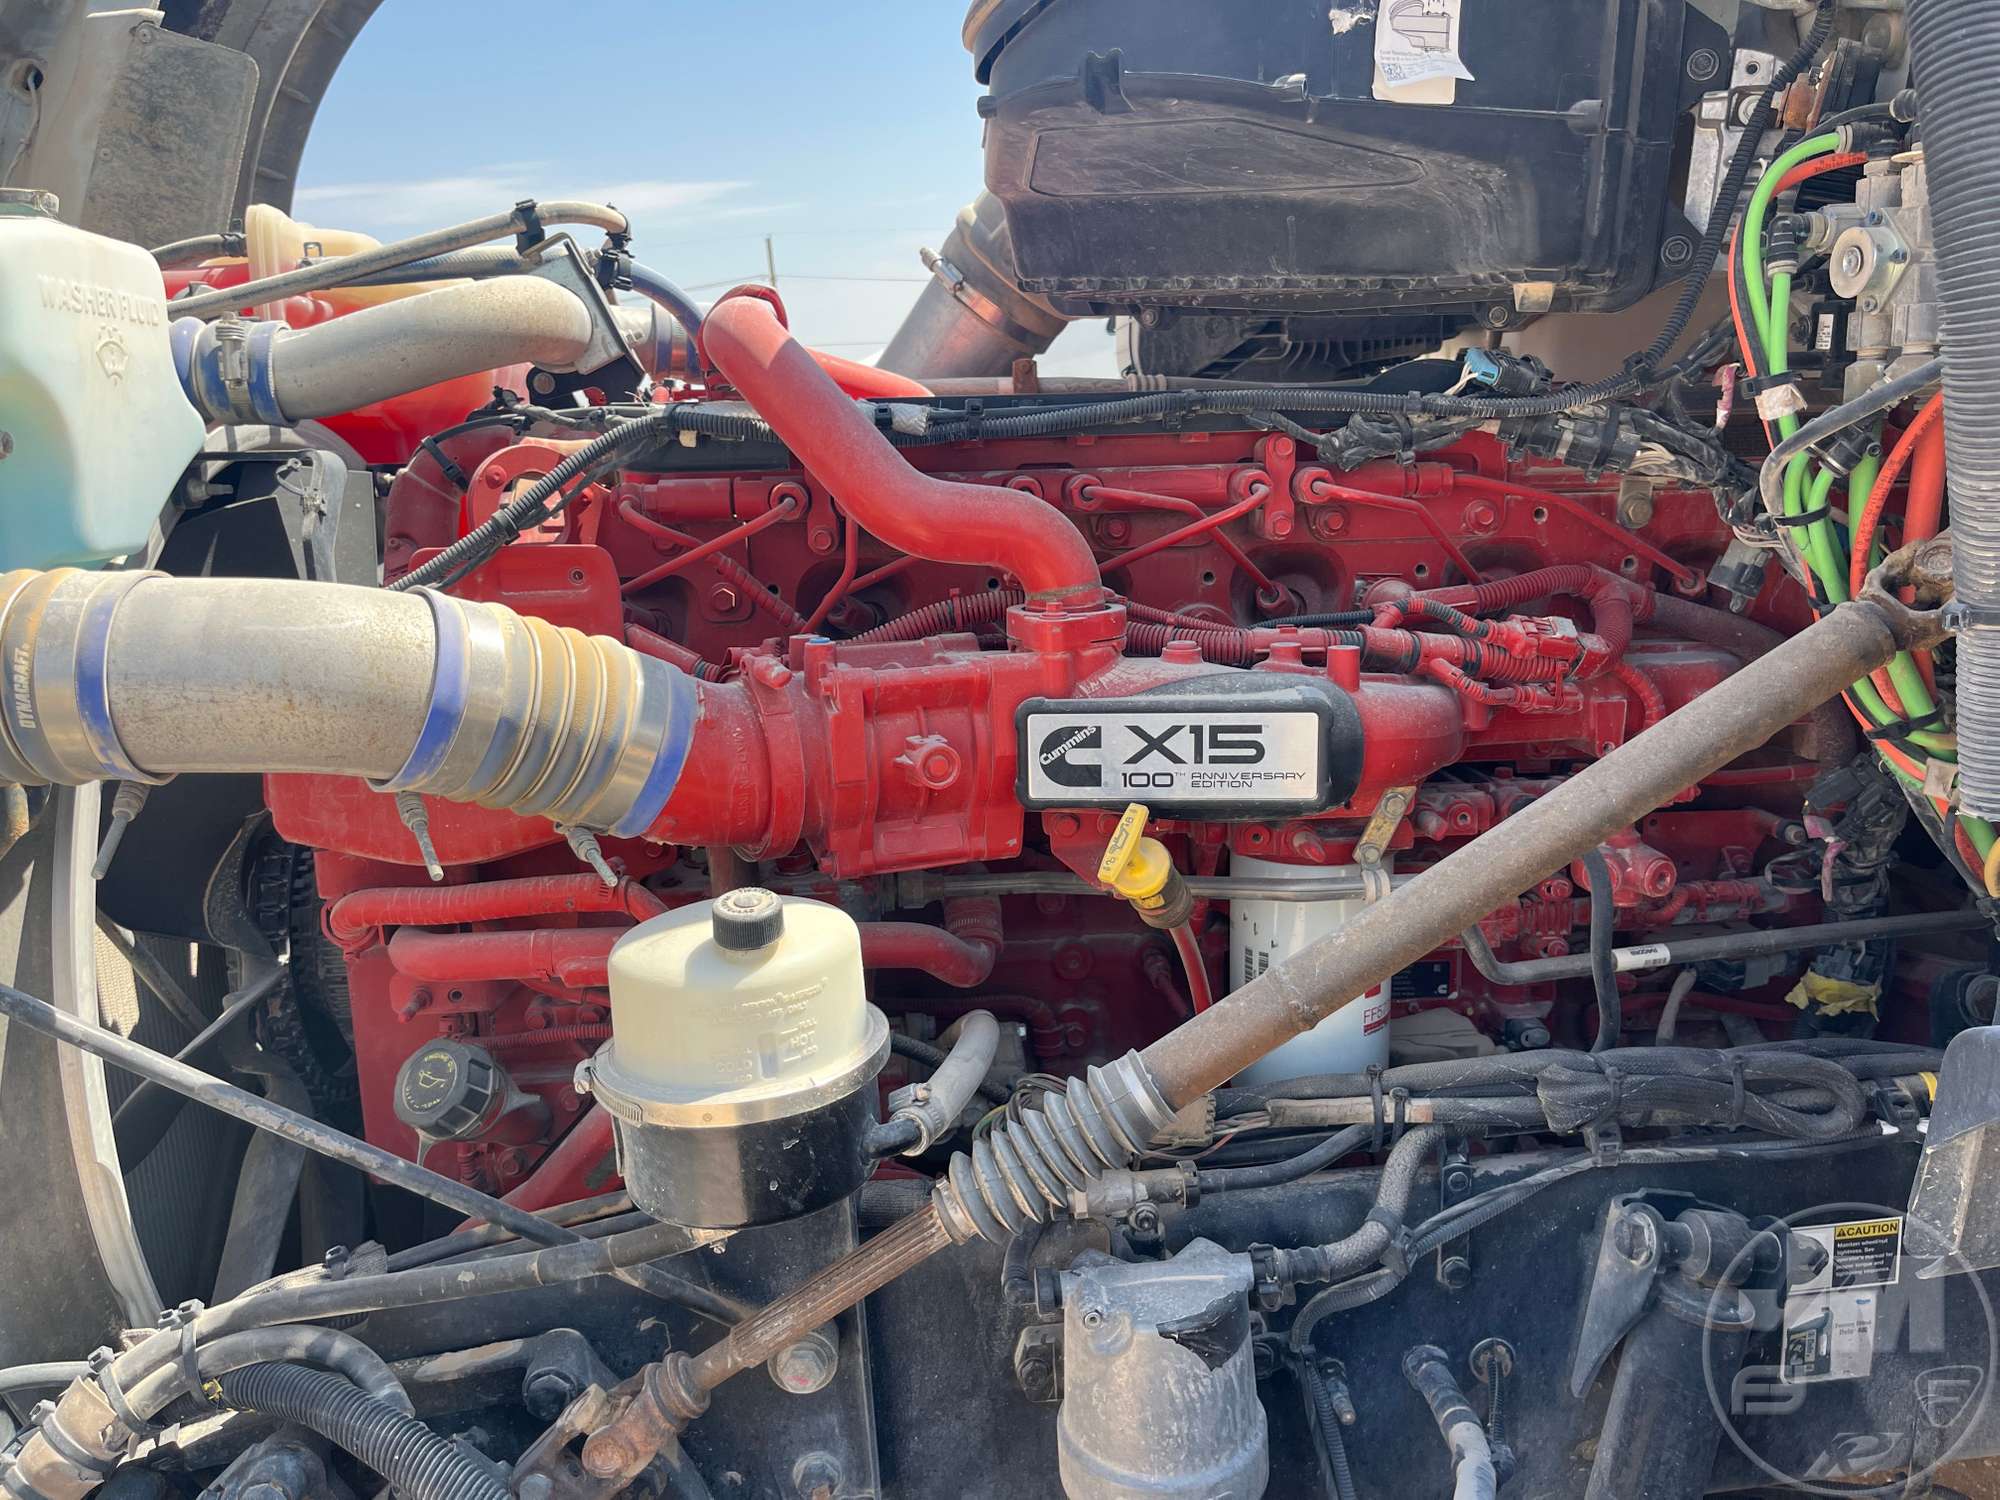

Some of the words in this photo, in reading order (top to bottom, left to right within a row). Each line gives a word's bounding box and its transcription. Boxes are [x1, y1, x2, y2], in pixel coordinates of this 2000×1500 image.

[38, 273, 116, 318] WASHER
[118, 290, 160, 327] FLUID
[14, 647, 36, 729] DYNACRAFT
[1039, 725, 1097, 766] Cummins
[1123, 724, 1265, 765] X15
[1191, 771, 1307, 780] ANNIVERSARY
[1191, 780, 1253, 788] EDITION
[791, 1030, 815, 1048] HOT
[1846, 1222, 1898, 1236] CAUTION
